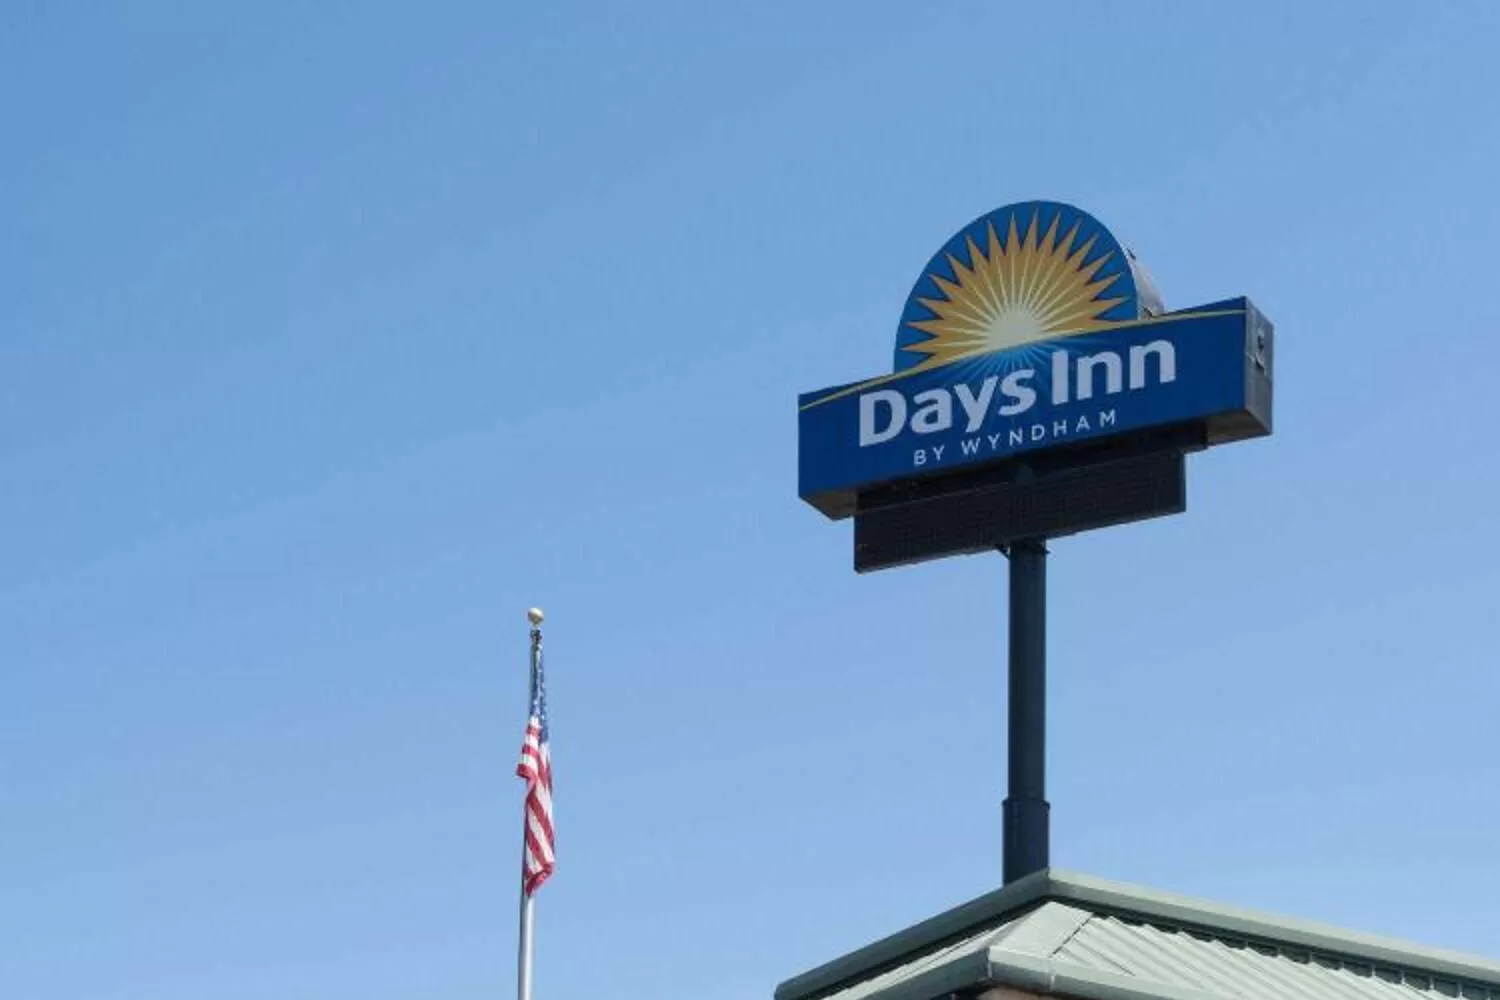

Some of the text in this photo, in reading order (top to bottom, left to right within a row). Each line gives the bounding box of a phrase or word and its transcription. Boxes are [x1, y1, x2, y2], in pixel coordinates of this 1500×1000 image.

[858, 339, 1177, 448] Days Inn
[913, 409, 1118, 466] BY WYNDHAM
